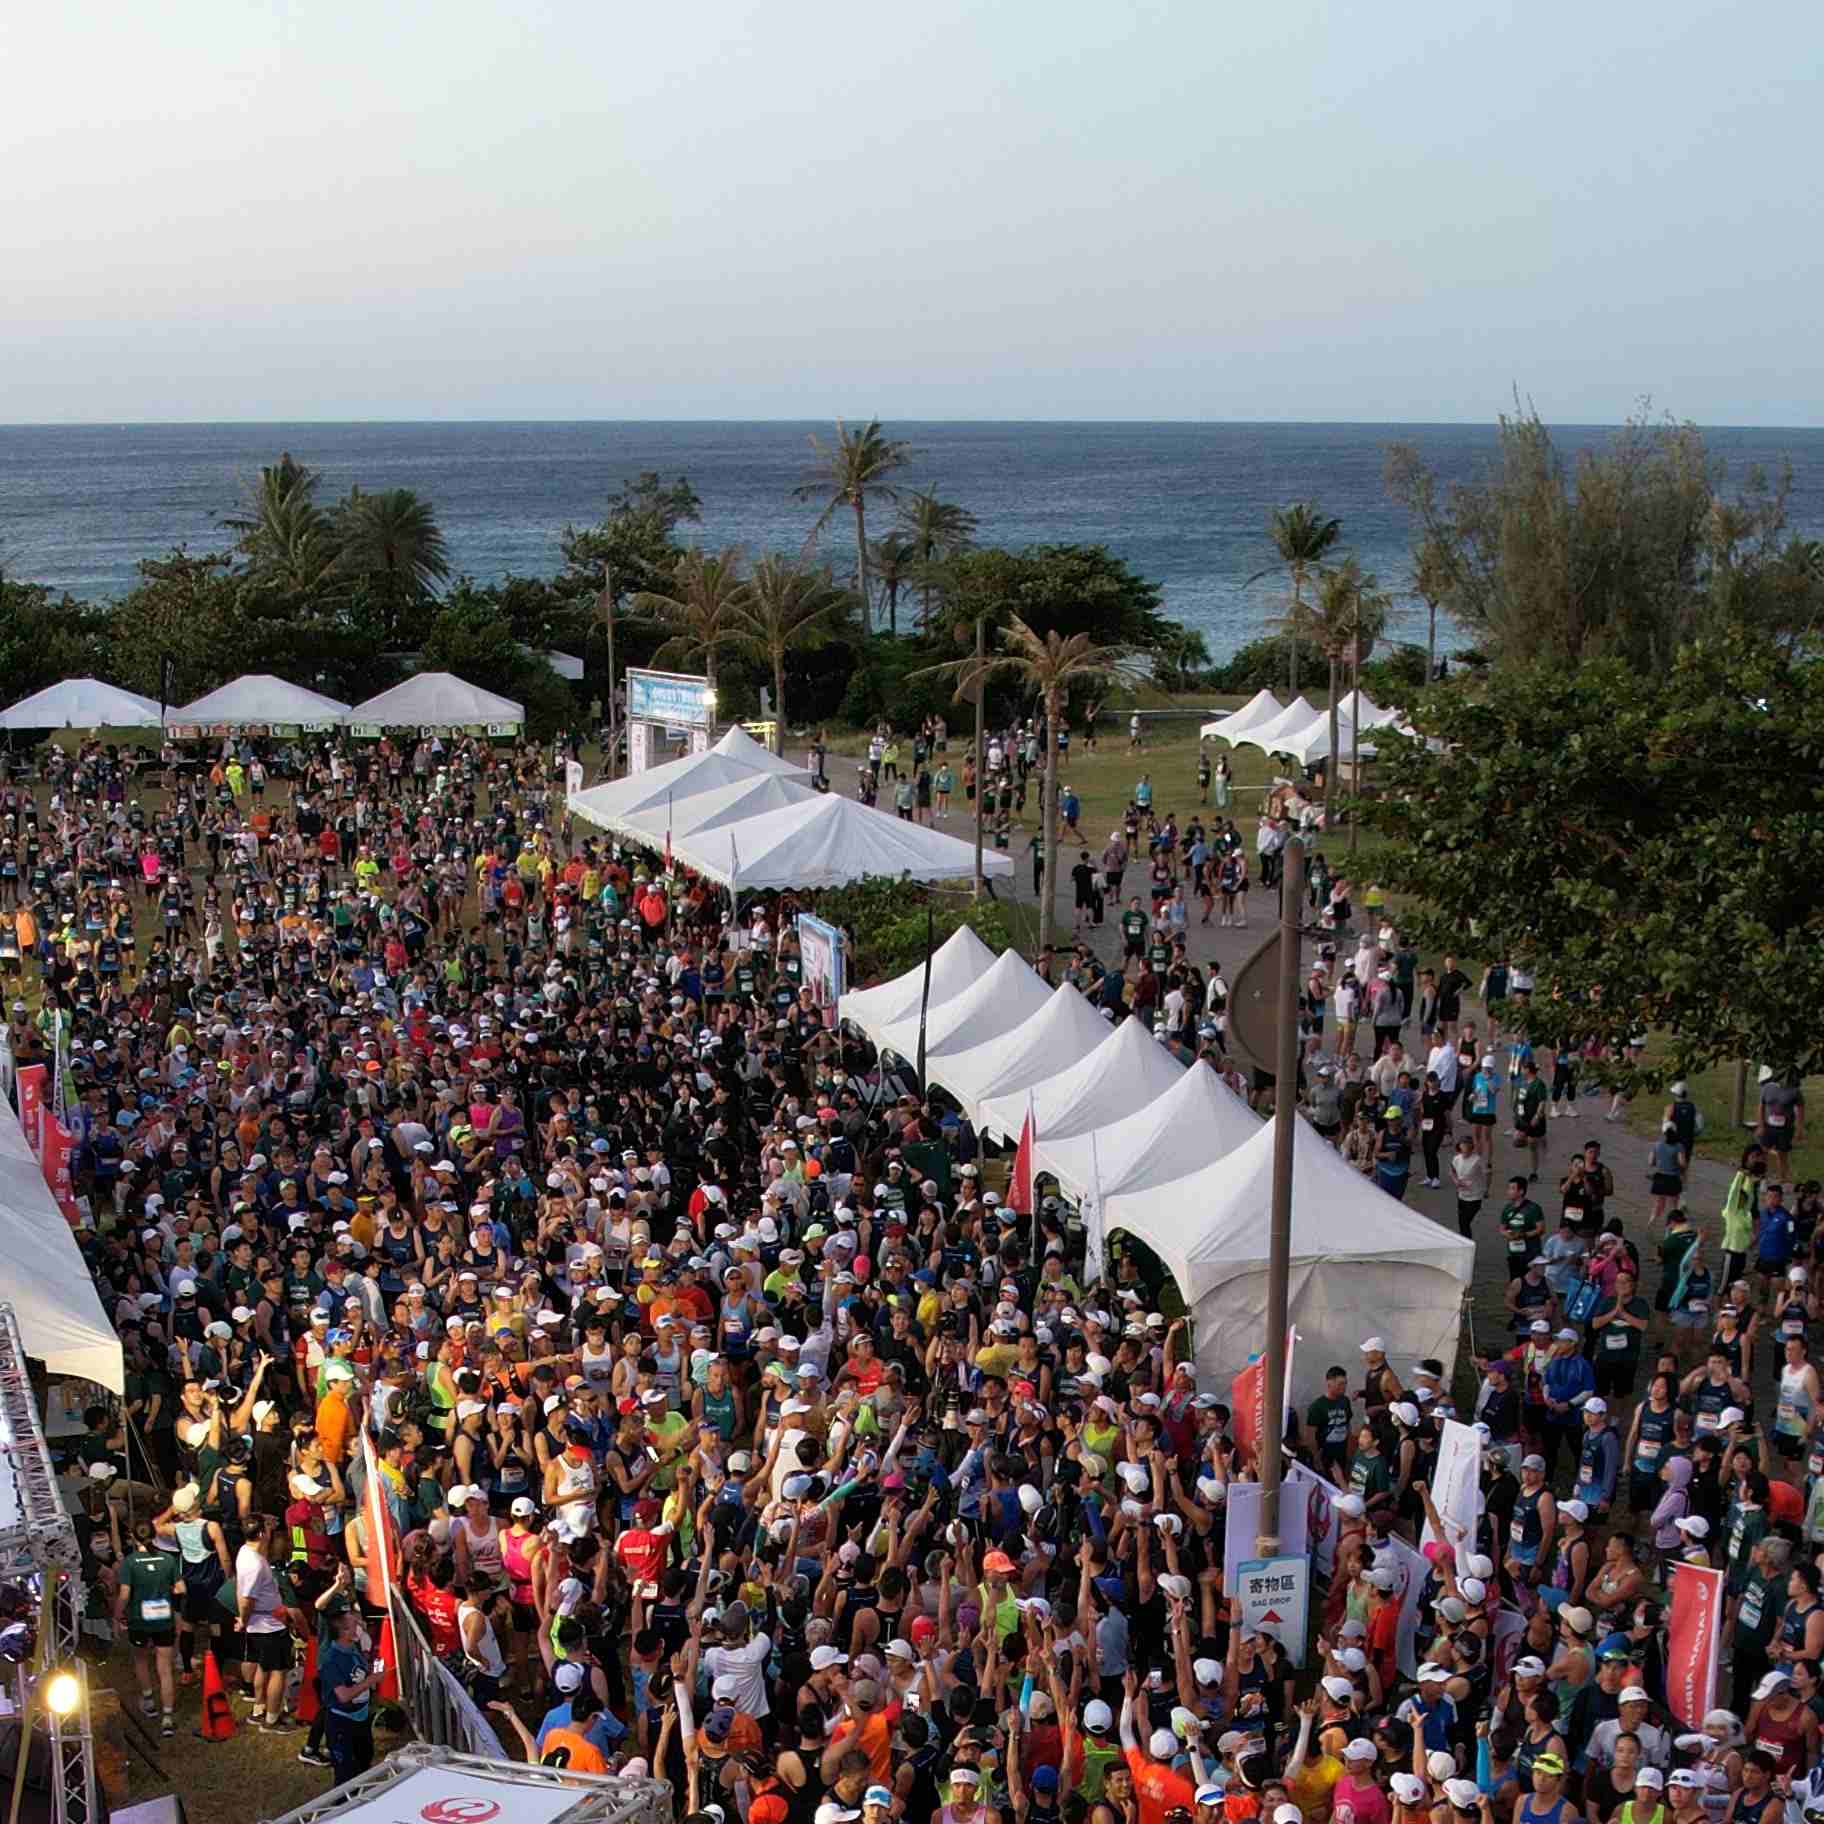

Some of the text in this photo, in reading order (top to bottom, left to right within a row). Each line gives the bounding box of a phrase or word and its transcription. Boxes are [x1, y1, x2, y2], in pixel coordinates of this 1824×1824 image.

[1249, 1575, 1295, 1594] 寄物區
[1252, 1597, 1292, 1608] BAG DROP
